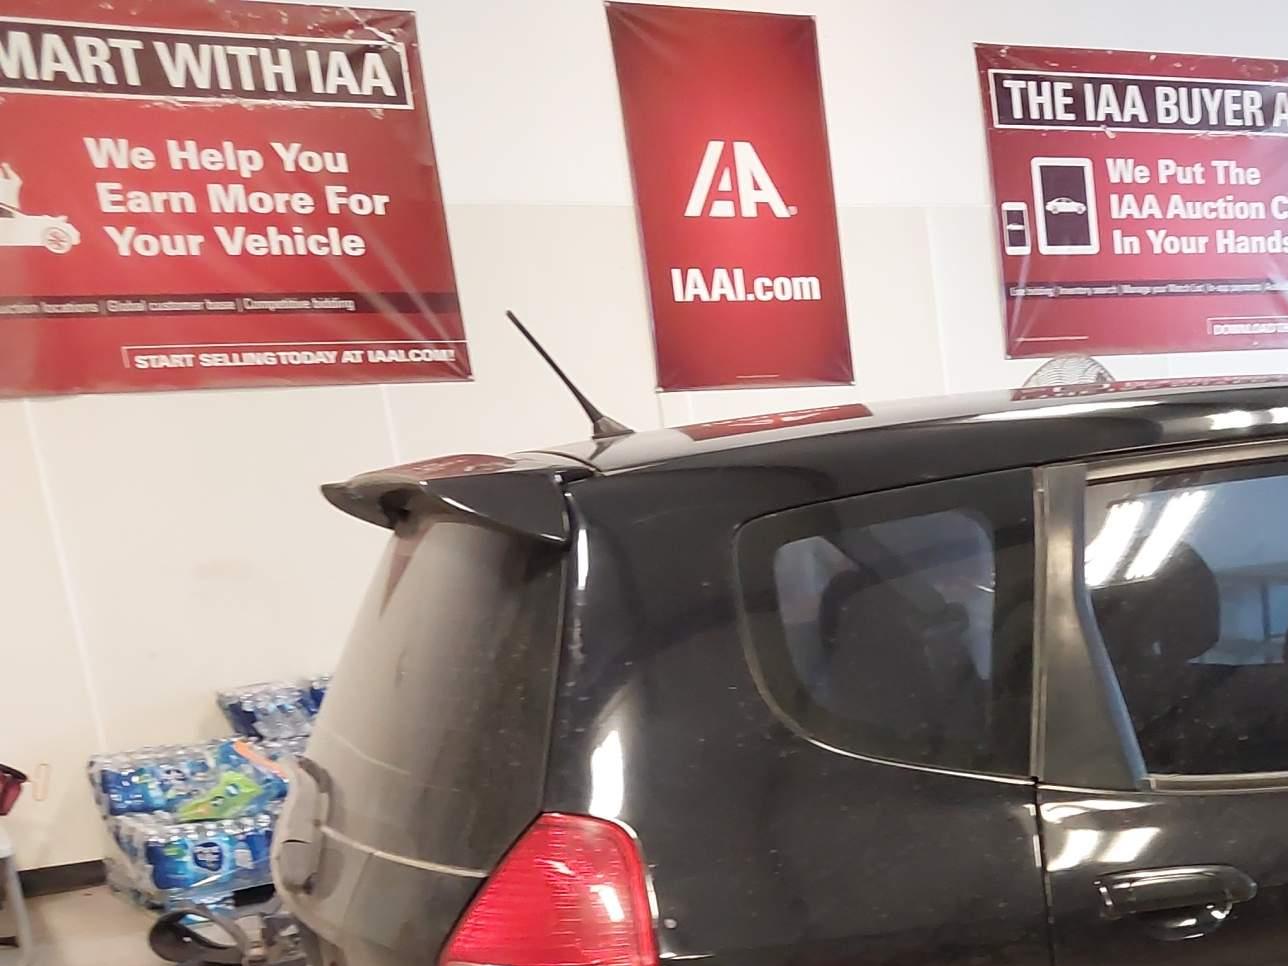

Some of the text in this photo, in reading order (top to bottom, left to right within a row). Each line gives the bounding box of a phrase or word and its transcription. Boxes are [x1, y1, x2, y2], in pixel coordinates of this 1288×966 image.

[153, 41, 297, 93] WITH
[307, 49, 397, 97] IAA
[1003, 79, 1077, 121] THE
[1083, 83, 1149, 123] IAA
[1155, 86, 1265, 127] BUYER
[83, 137, 349, 178] We Help You
[1106, 158, 1261, 185] We Put The
[96, 182, 390, 216] Earn More For
[1109, 194, 1163, 219] IAA
[1166, 195, 1266, 219] Auction
[103, 225, 366, 257] Your Vehicle
[1112, 229, 1141, 254] In
[1146, 229, 1209, 254] Your
[671, 268, 821, 302] IAAI.com
[134, 353, 195, 369] START
[275, 351, 338, 367] TODAY
[341, 350, 364, 364] AT
